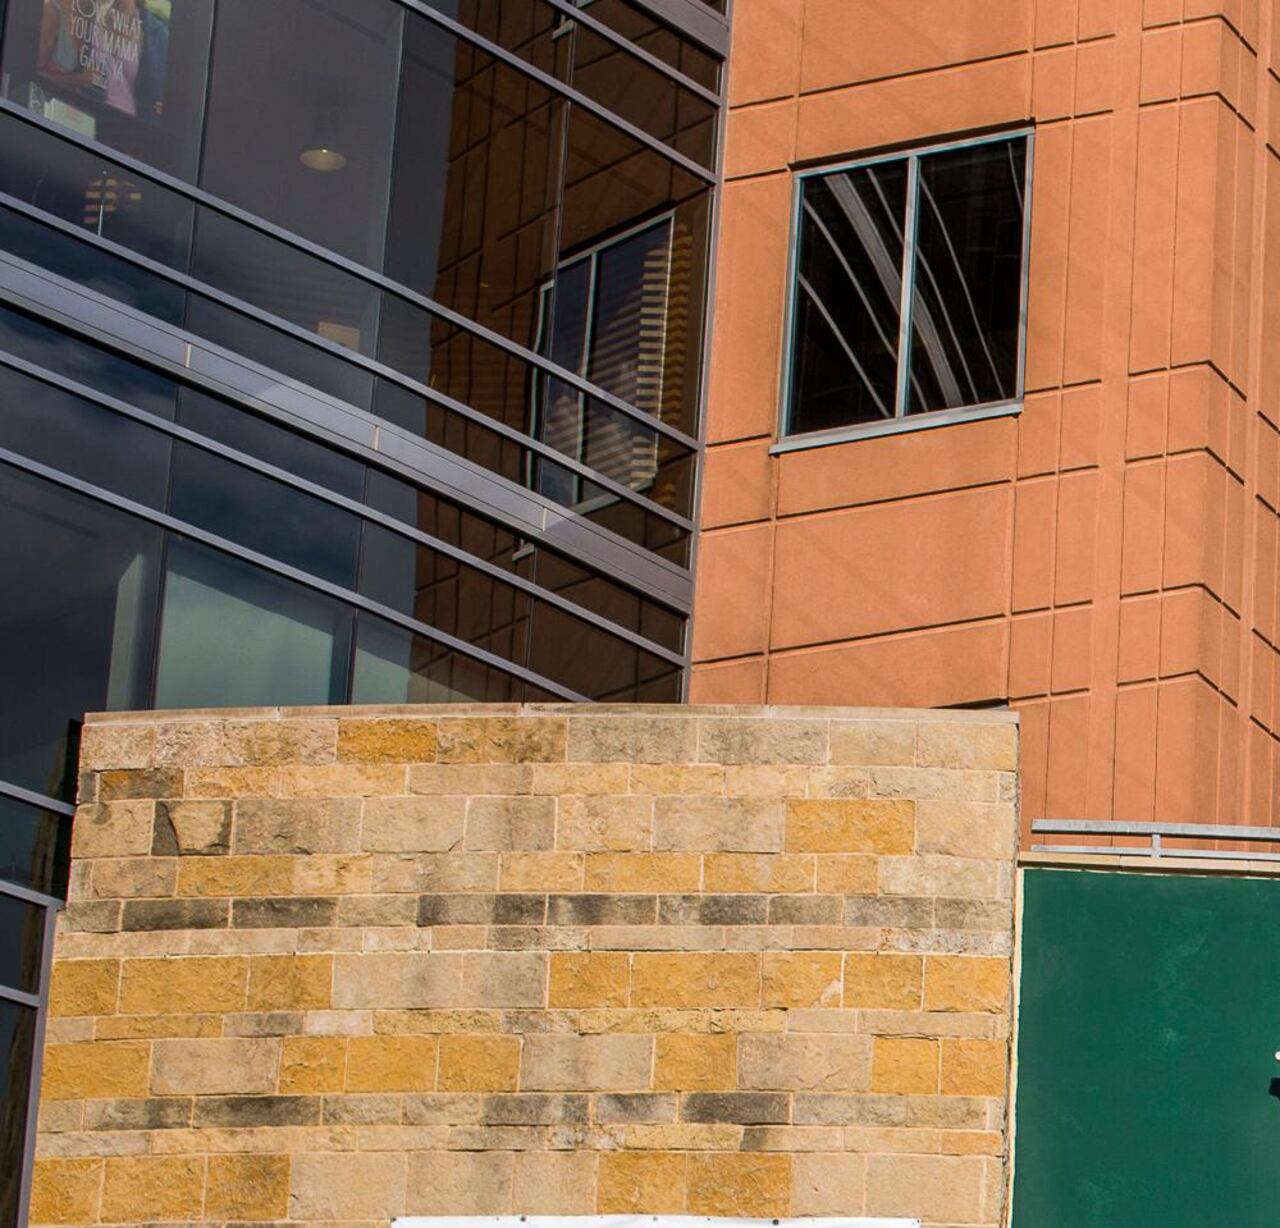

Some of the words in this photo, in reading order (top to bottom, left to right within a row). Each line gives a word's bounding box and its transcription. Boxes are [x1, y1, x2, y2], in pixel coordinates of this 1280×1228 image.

[69, 13, 102, 50] YOUR
[103, 30, 139, 65] MAMA
[110, 8, 142, 41] WHAT
